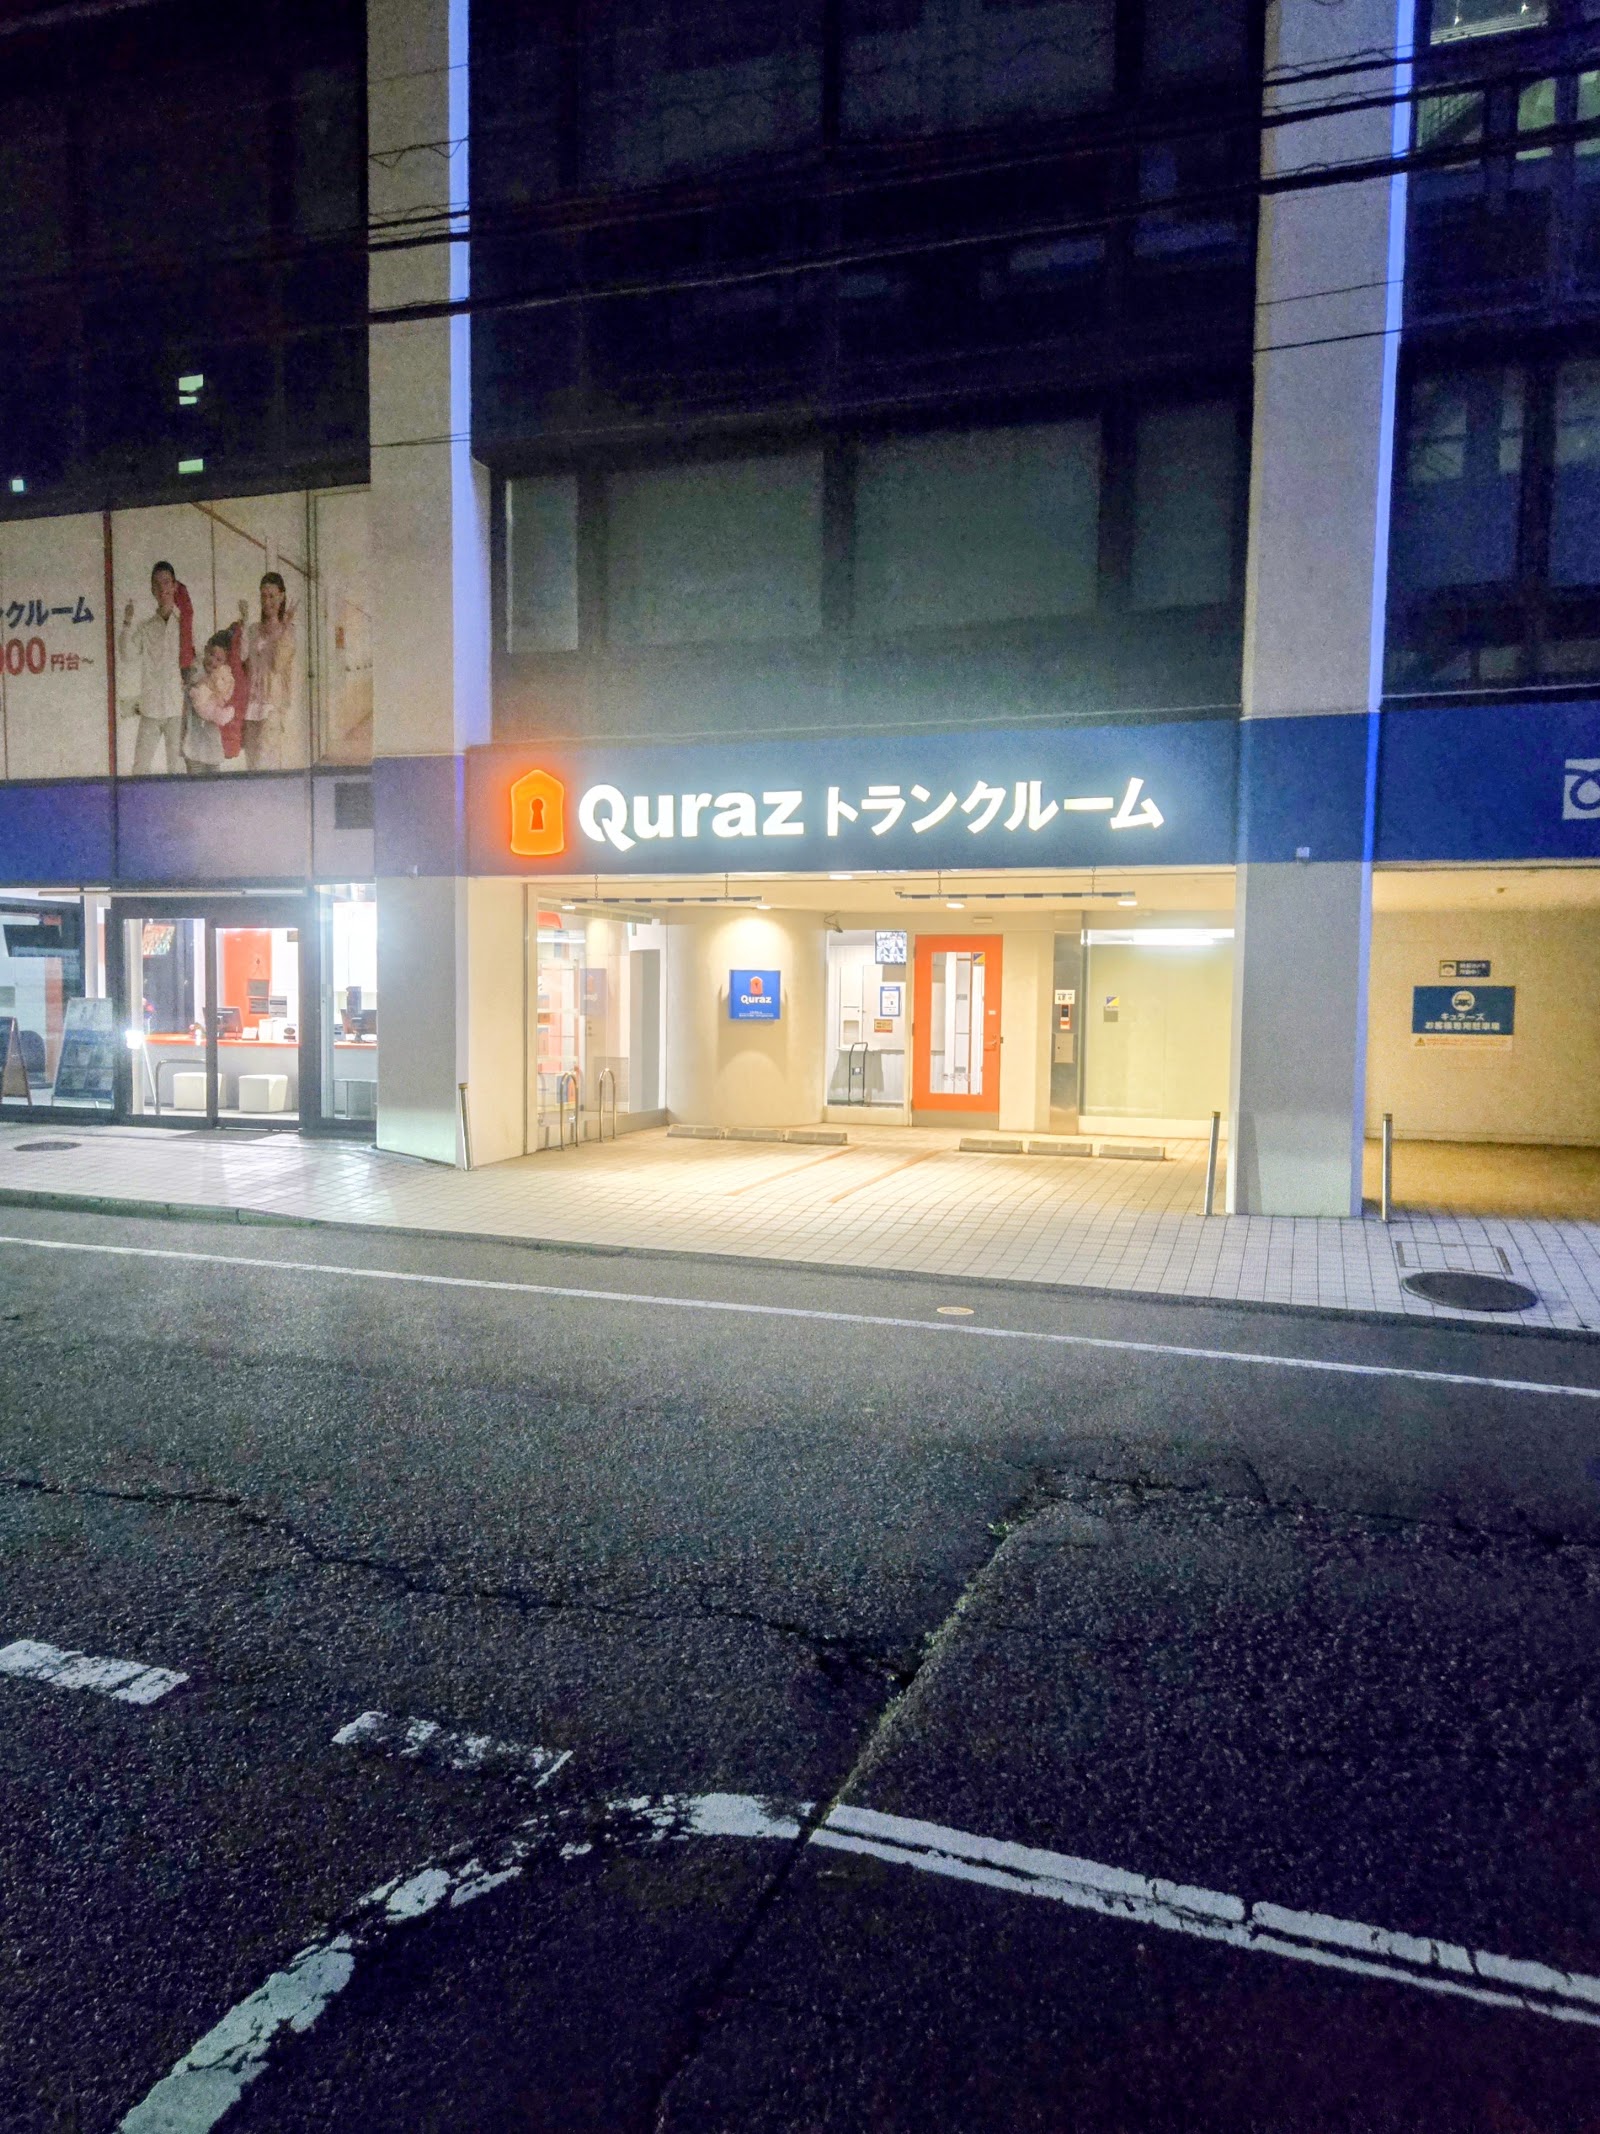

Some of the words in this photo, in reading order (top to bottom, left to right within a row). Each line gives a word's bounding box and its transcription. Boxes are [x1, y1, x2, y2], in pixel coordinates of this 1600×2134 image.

[0, 597, 95, 629] クルーム
[578, 784, 805, 852] Quraz
[827, 777, 1165, 837] トランクルーム
[740, 994, 773, 1005] Quraz
[1440, 1012, 1485, 1021] キュラーズ
